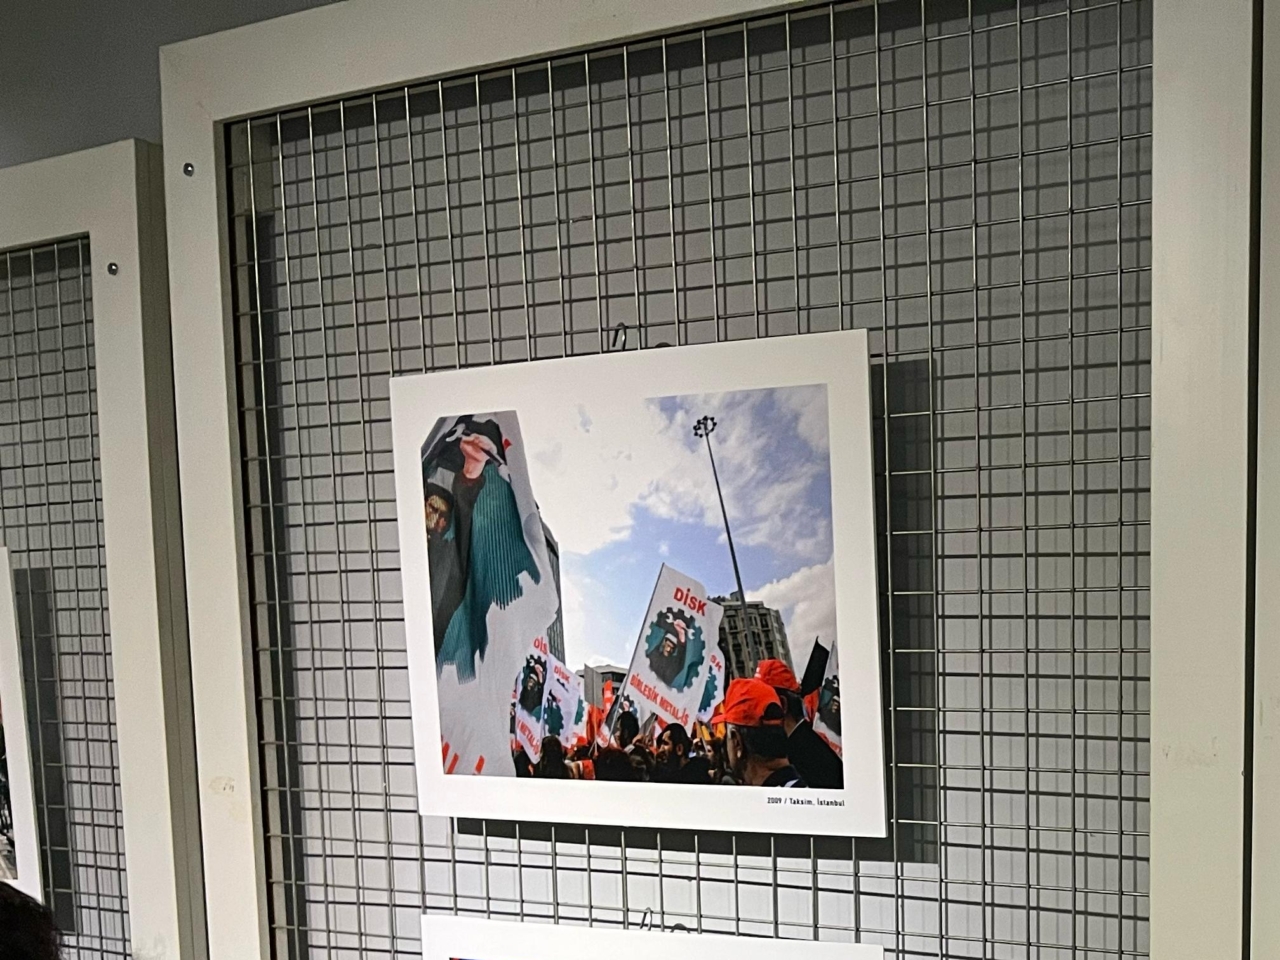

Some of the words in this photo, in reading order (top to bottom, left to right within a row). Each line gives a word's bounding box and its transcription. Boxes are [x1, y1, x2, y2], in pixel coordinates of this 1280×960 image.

[673, 587, 708, 616] DİSK
[533, 636, 549, 656] DİS
[767, 796, 782, 804] 2009
[817, 797, 845, 807] İstanbul
